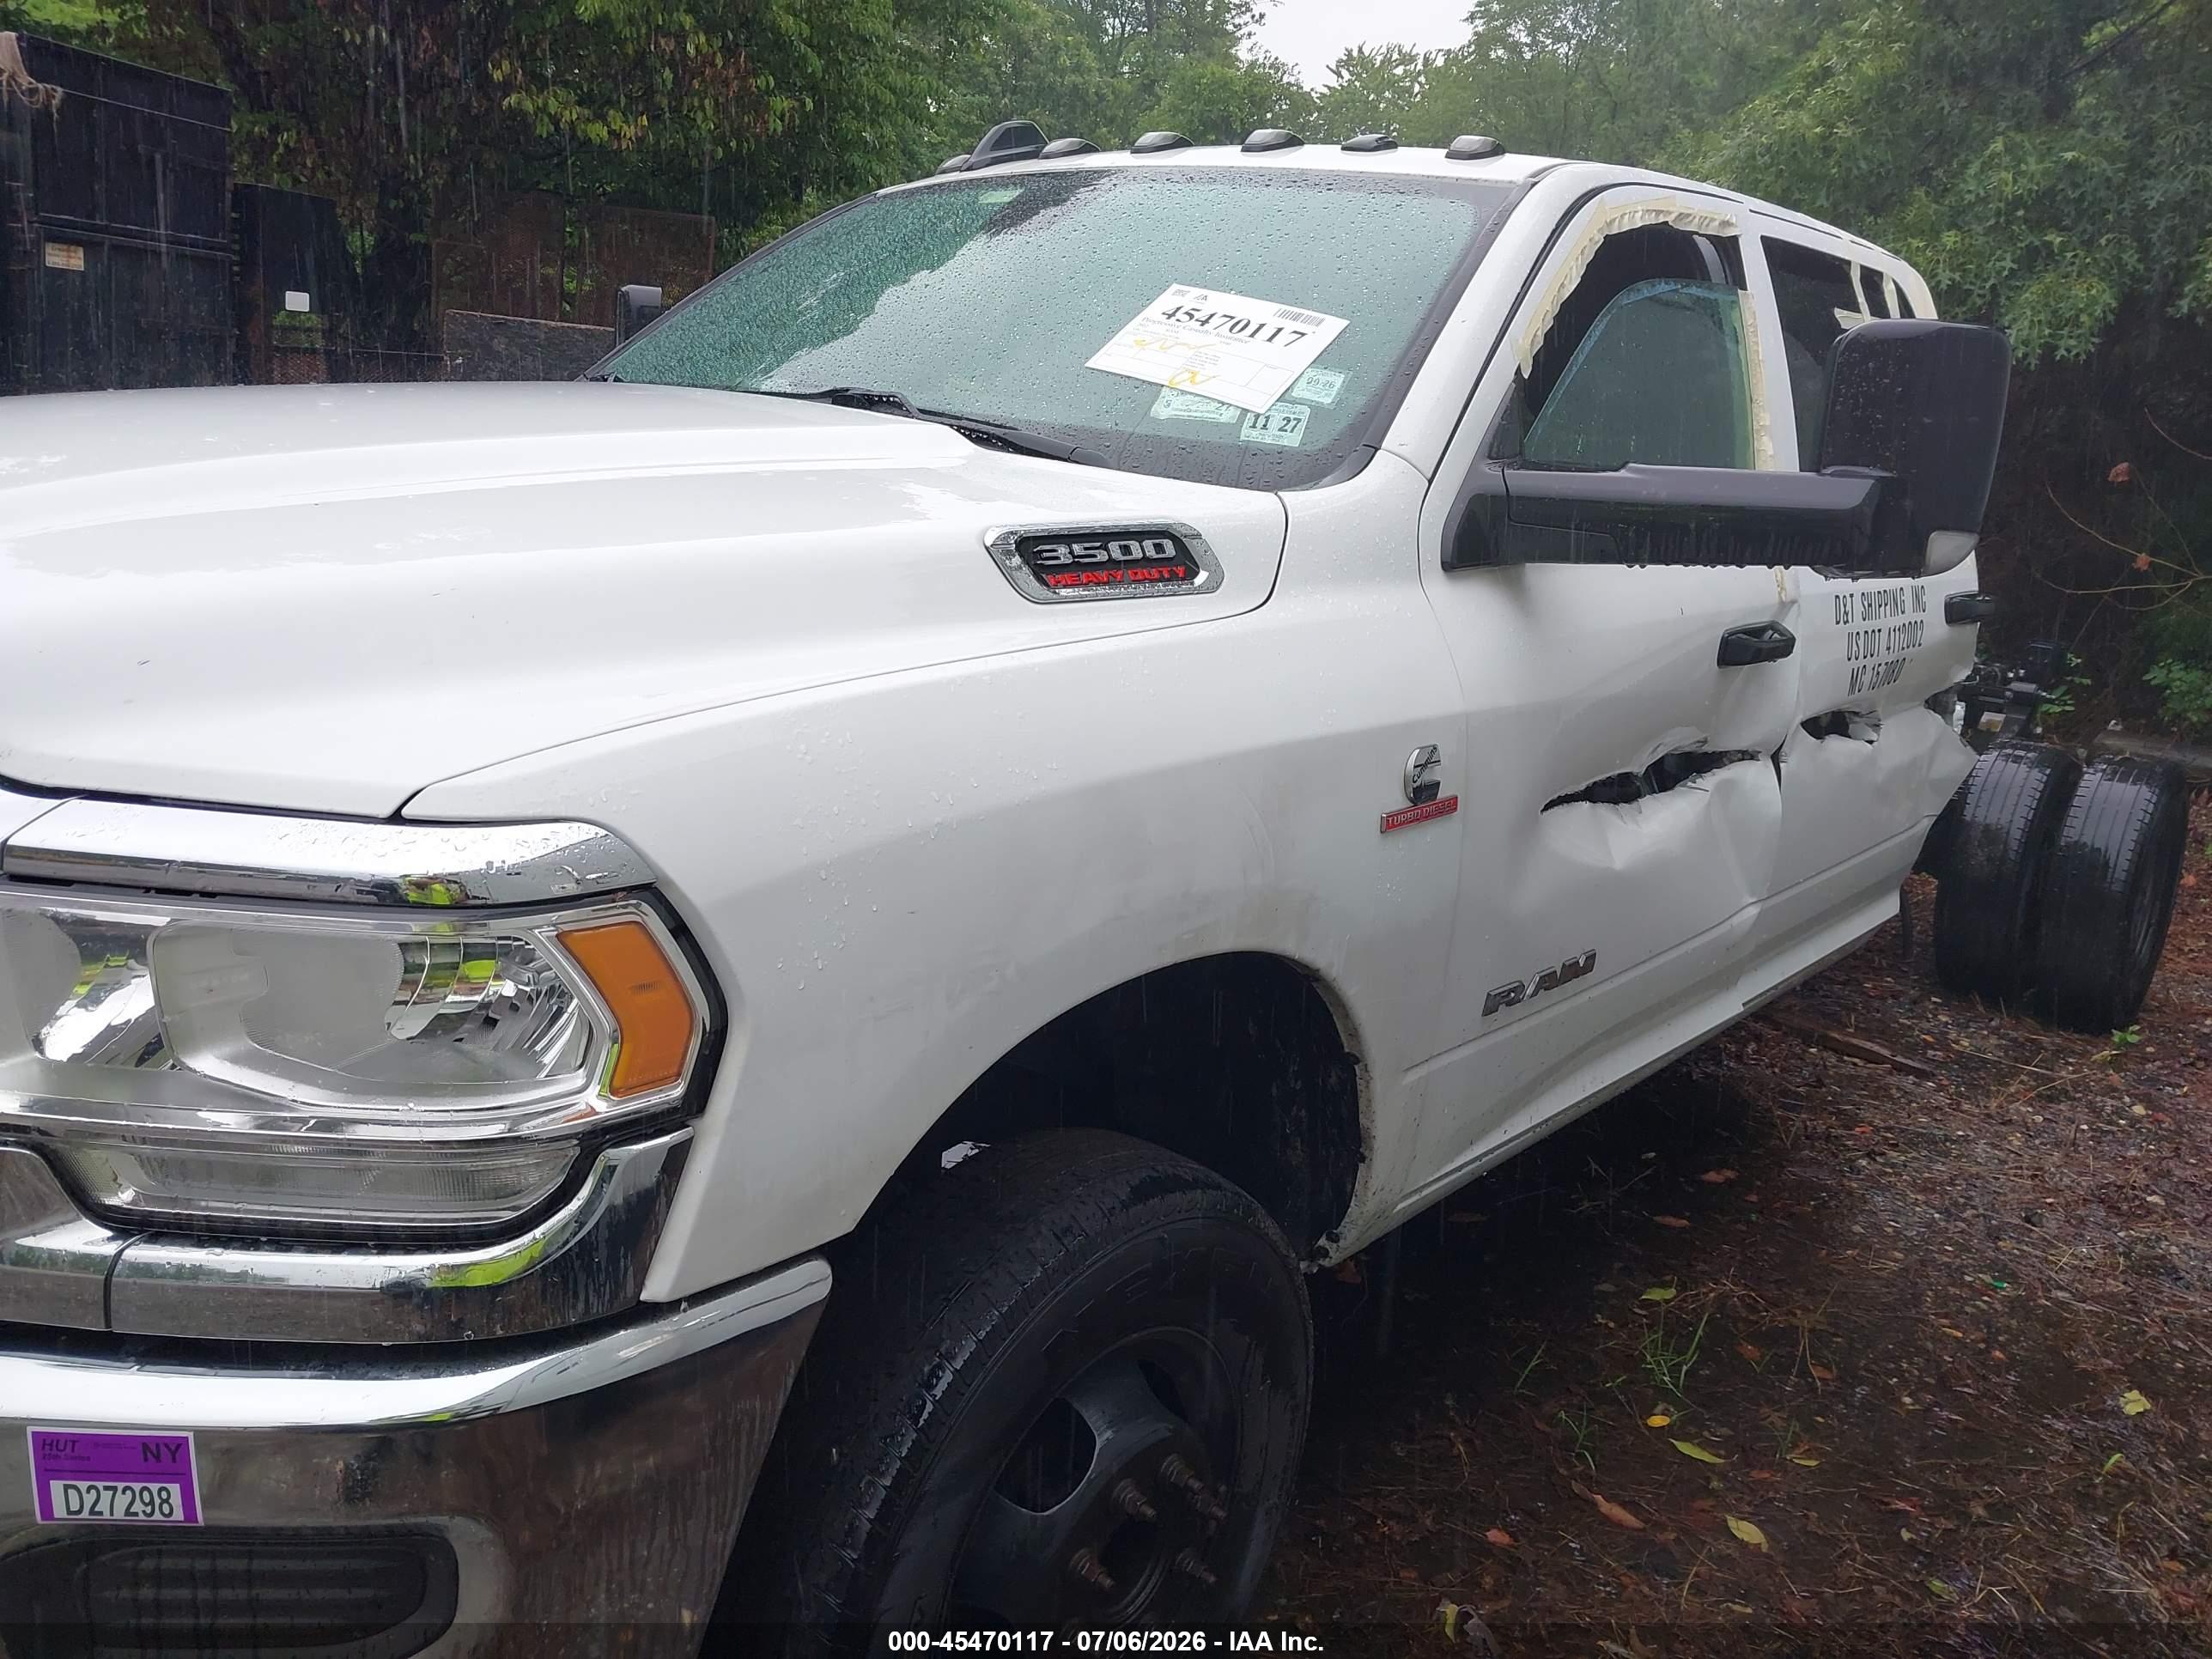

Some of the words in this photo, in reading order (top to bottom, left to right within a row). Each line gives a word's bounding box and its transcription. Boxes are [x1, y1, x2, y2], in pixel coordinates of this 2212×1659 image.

[1161, 305, 1307, 348] 45470117
[1249, 413, 1271, 430] 11
[1278, 416, 1304, 434] 27
[1034, 539, 1176, 565] 3500
[1046, 568, 1126, 587] HEAVY
[1128, 566, 1187, 584] DUTY
[1834, 592, 1855, 625] D&T
[1861, 586, 1905, 622] SHIPPING
[1911, 585, 1927, 614] INC
[1886, 619, 1924, 655] 4112002
[1848, 665, 1867, 696] MC
[1413, 746, 1437, 784] Cummins
[1387, 809, 1421, 827] TURBO
[1423, 800, 1457, 817] DIESEL
[1481, 949, 1597, 1018] RAM
[41, 1438, 80, 1453] HUT
[142, 1442, 183, 1464] NY
[63, 1483, 174, 1519] D27298
